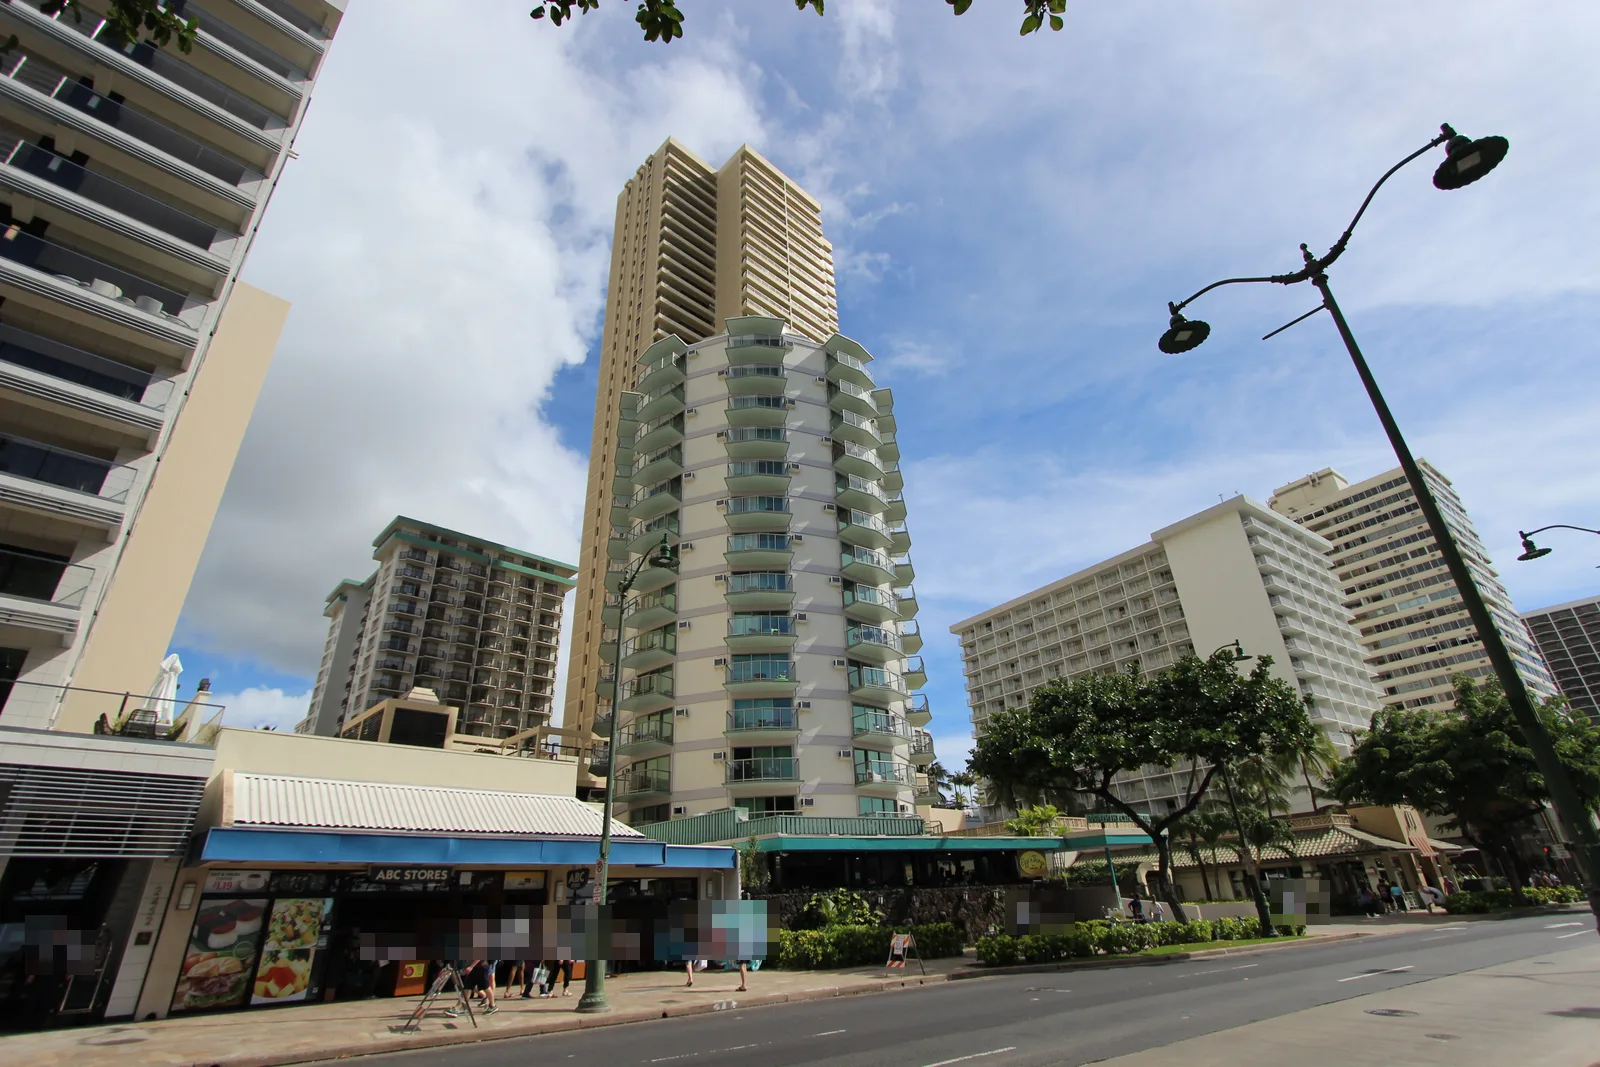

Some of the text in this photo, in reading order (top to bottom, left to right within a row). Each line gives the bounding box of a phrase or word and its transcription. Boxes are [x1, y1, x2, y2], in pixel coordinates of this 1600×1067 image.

[375, 869, 448, 880] ABC STORES
[568, 870, 585, 884] ABC
